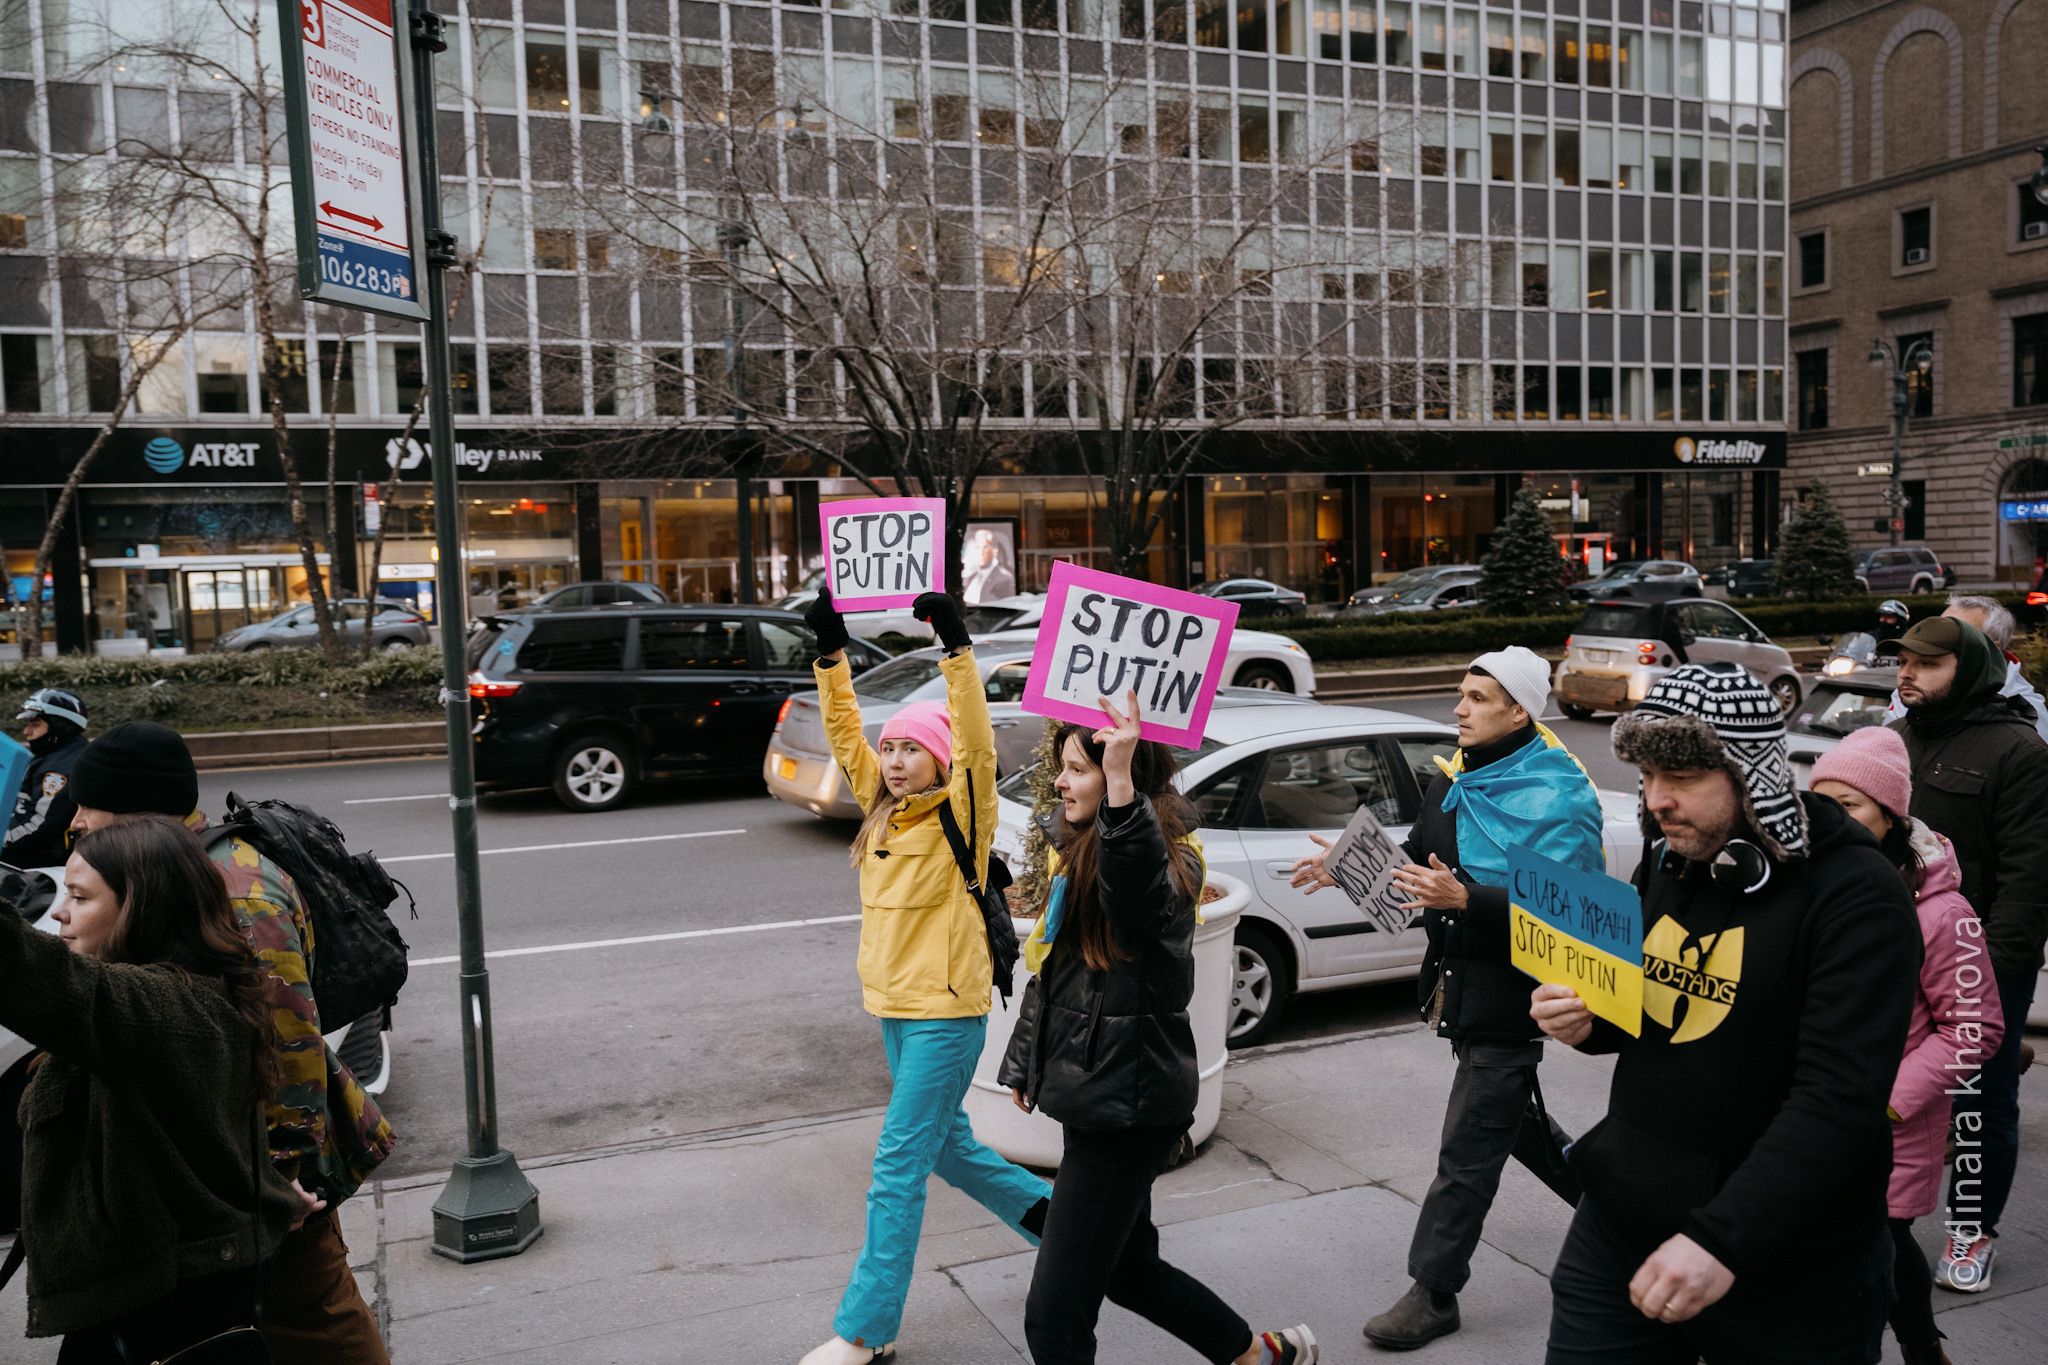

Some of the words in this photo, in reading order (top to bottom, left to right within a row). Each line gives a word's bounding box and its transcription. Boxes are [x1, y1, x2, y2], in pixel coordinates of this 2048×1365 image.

[301, 0, 321, 42] 3
[306, 56, 380, 104] COMMERCIAL
[308, 80, 363, 119] VEHICLES
[366, 106, 393, 132] ONLY
[311, 113, 345, 138] OTHERS
[347, 127, 359, 143] NO
[361, 133, 400, 159] STANDING
[312, 140, 348, 169] Monday
[357, 156, 383, 182] Friday
[314, 161, 340, 182] 10am
[347, 172, 367, 193] 4pm
[319, 254, 391, 294] 106283
[188, 443, 260, 467] AT&T
[424, 442, 493, 473] lley
[497, 450, 543, 461] BANK
[1695, 440, 1766, 464] Fidelity
[832, 512, 931, 555] STOP
[1071, 593, 1203, 657] STOP
[1516, 914, 1556, 966] STOP
[1564, 946, 1616, 996] PUTIN
